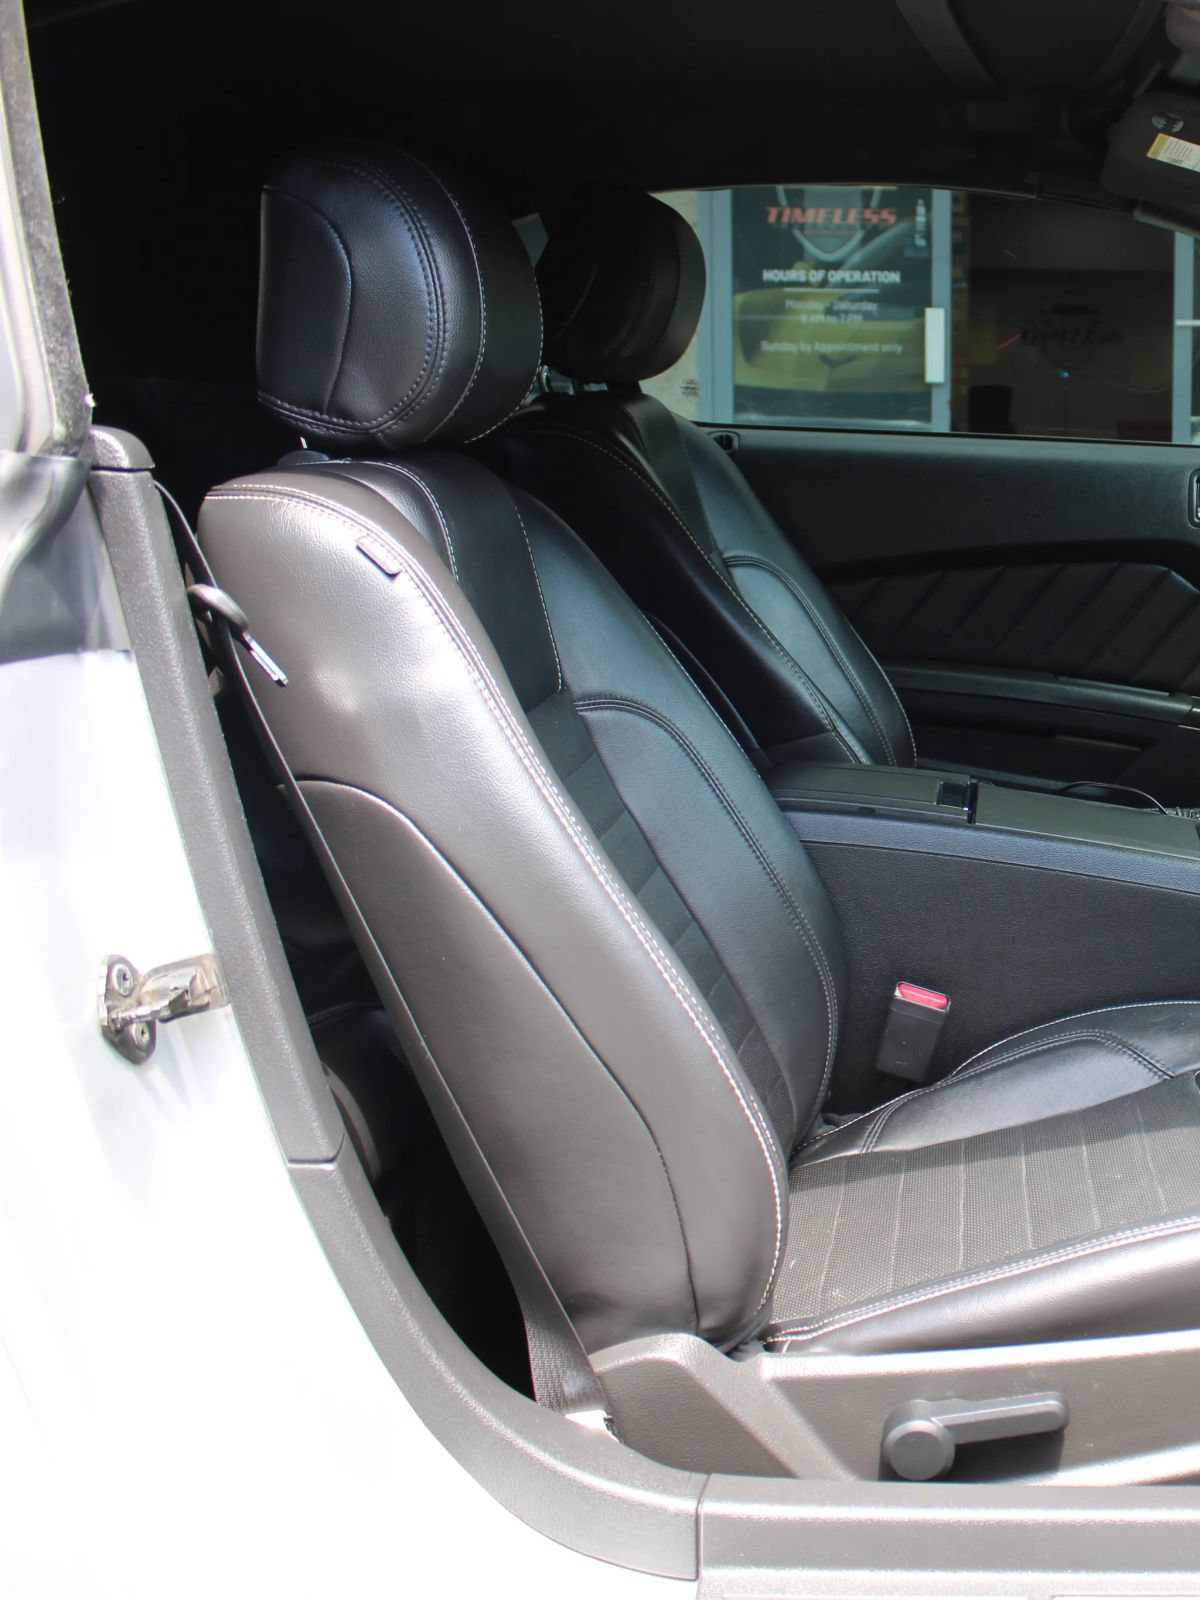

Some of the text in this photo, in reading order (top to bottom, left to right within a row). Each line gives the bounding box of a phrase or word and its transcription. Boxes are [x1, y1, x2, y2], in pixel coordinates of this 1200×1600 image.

[767, 207, 897, 224] TIMELESS
[762, 269, 901, 283] HOURS OF OPERATION
